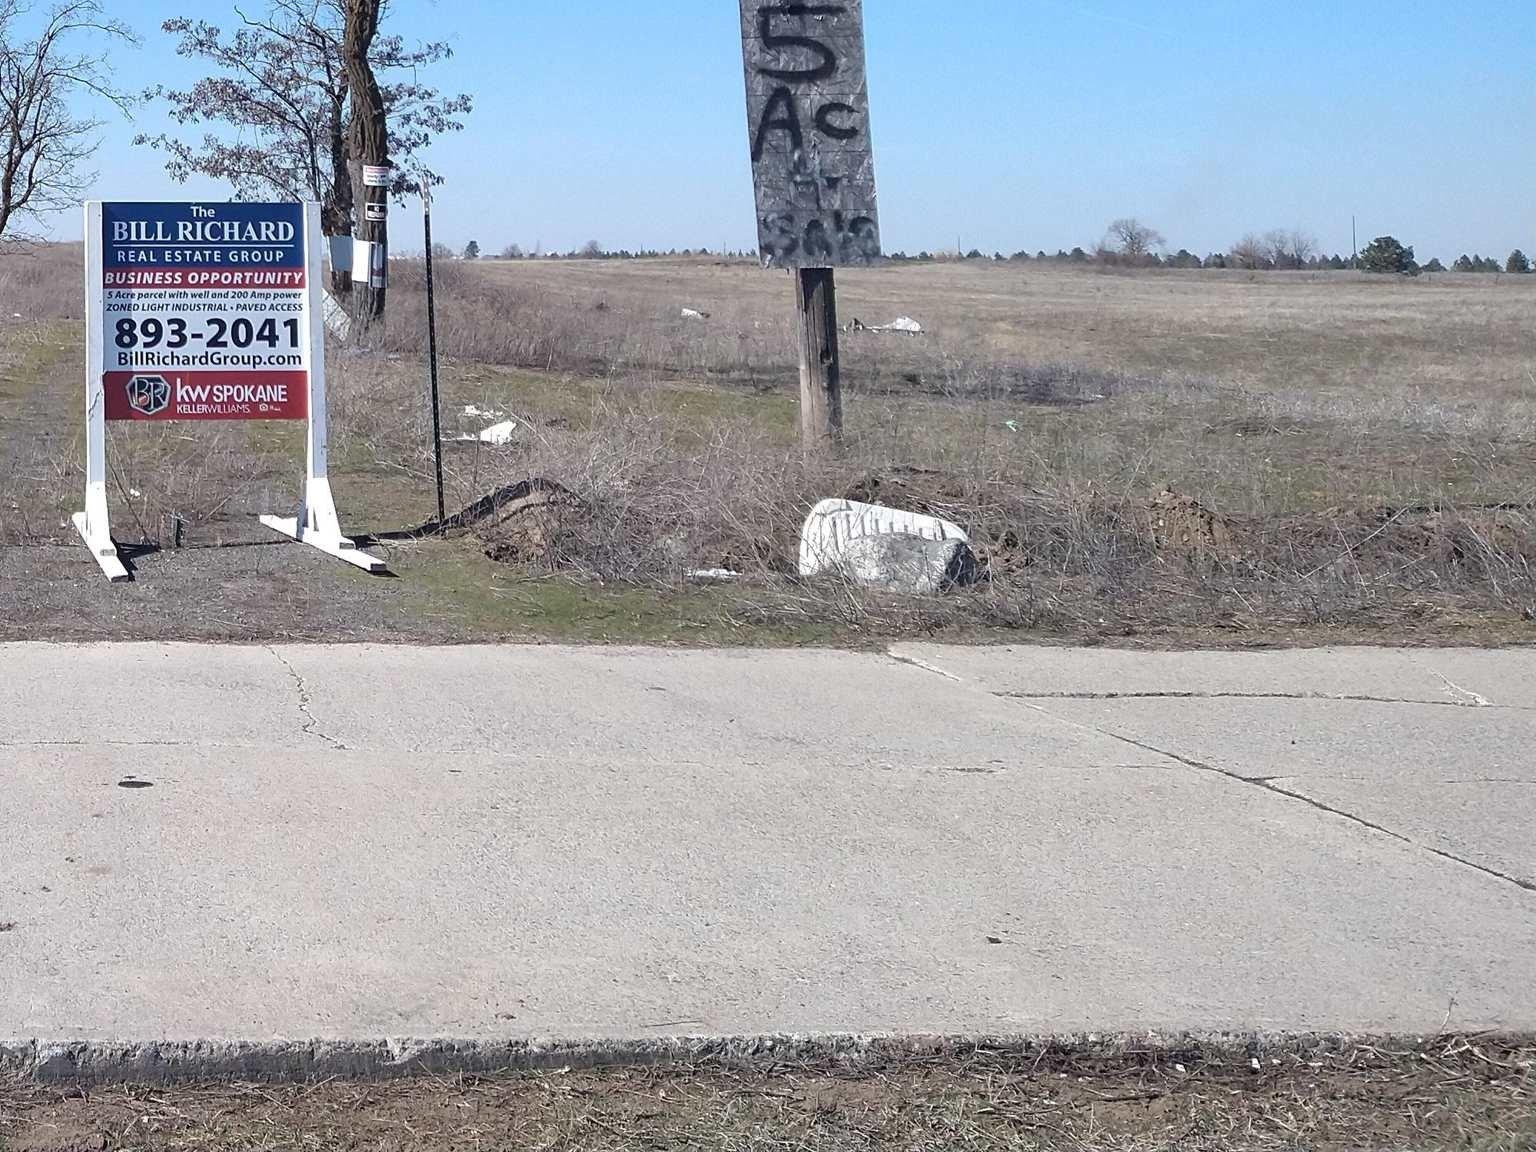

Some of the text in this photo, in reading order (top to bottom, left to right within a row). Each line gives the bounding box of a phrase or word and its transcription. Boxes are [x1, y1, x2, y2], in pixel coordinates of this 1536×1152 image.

[756, 4, 849, 81] 5
[190, 206, 216, 218] The
[112, 220, 295, 242] BILL RICHARD
[117, 250, 284, 263] REAL ESTATE GROUP
[105, 271, 303, 285] BUSINESS OPPORTUNITY
[106, 290, 303, 301] 5 Acre parcel with well and 200 Amp power
[106, 303, 304, 312] ZONED LIGHT INDUSTRIAL PAVED ACCESS
[115, 317, 299, 349] 893-2041
[117, 350, 302, 369] BillRichardGroup.com
[213, 384, 288, 403] SPOKANE
